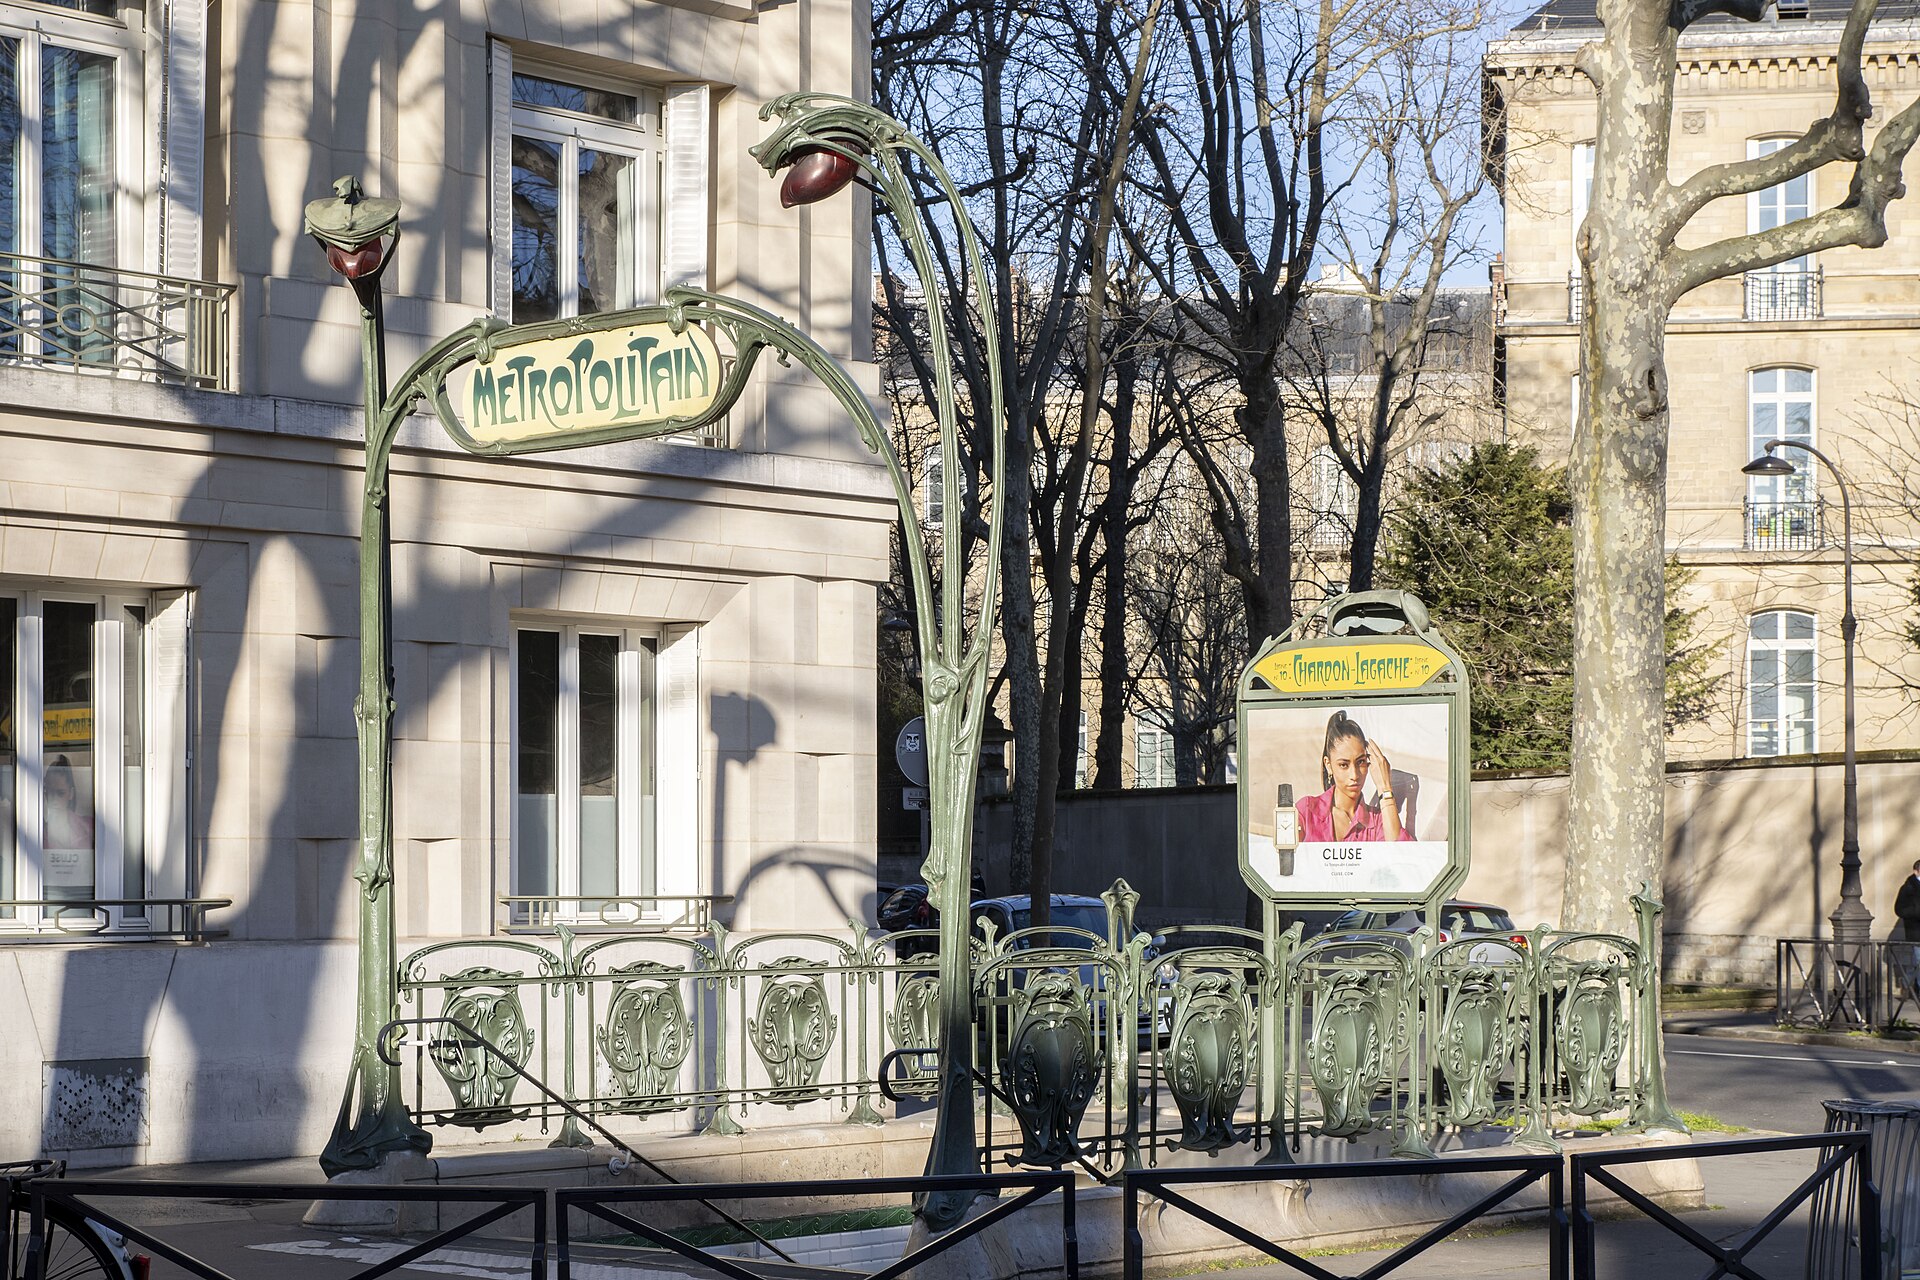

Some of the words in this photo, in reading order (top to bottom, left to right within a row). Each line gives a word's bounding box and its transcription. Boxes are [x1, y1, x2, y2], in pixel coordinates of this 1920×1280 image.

[473, 331, 709, 430] METROPOLITAIN
[1279, 670, 1288, 681] 10
[1293, 652, 1410, 687] CHARDON-LAGACHE
[1421, 664, 1430, 675] 10
[1322, 848, 1362, 860] CLUSE
